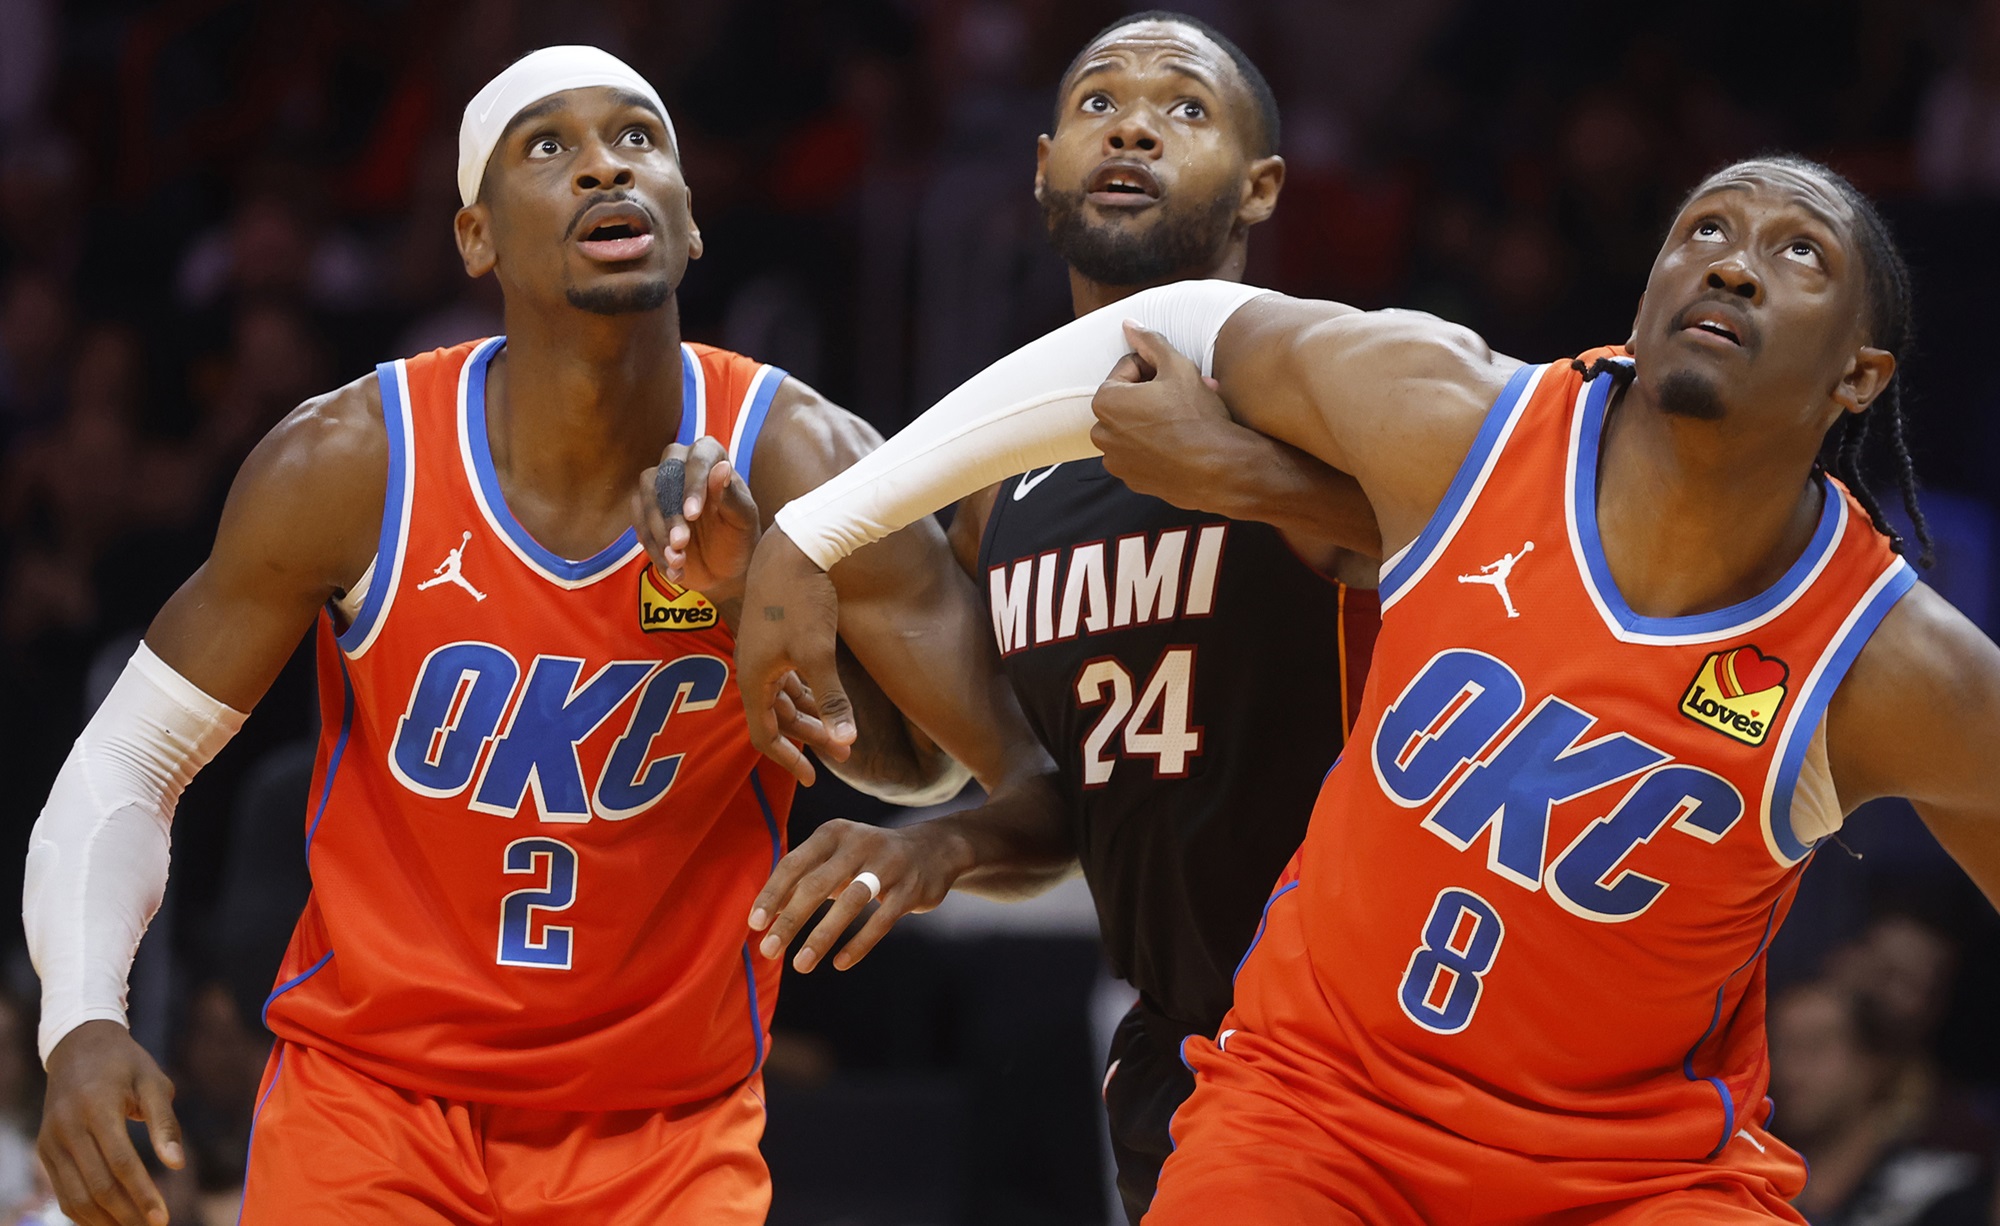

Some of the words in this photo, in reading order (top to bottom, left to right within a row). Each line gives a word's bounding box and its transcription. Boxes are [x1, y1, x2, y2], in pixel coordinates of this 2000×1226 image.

[989, 522, 1230, 659] MIAMI
[388, 641, 729, 823] OKC
[1073, 645, 1204, 789] 24
[1371, 648, 1745, 923] OKC
[496, 837, 578, 970] 2
[1398, 886, 1505, 1035] 8
